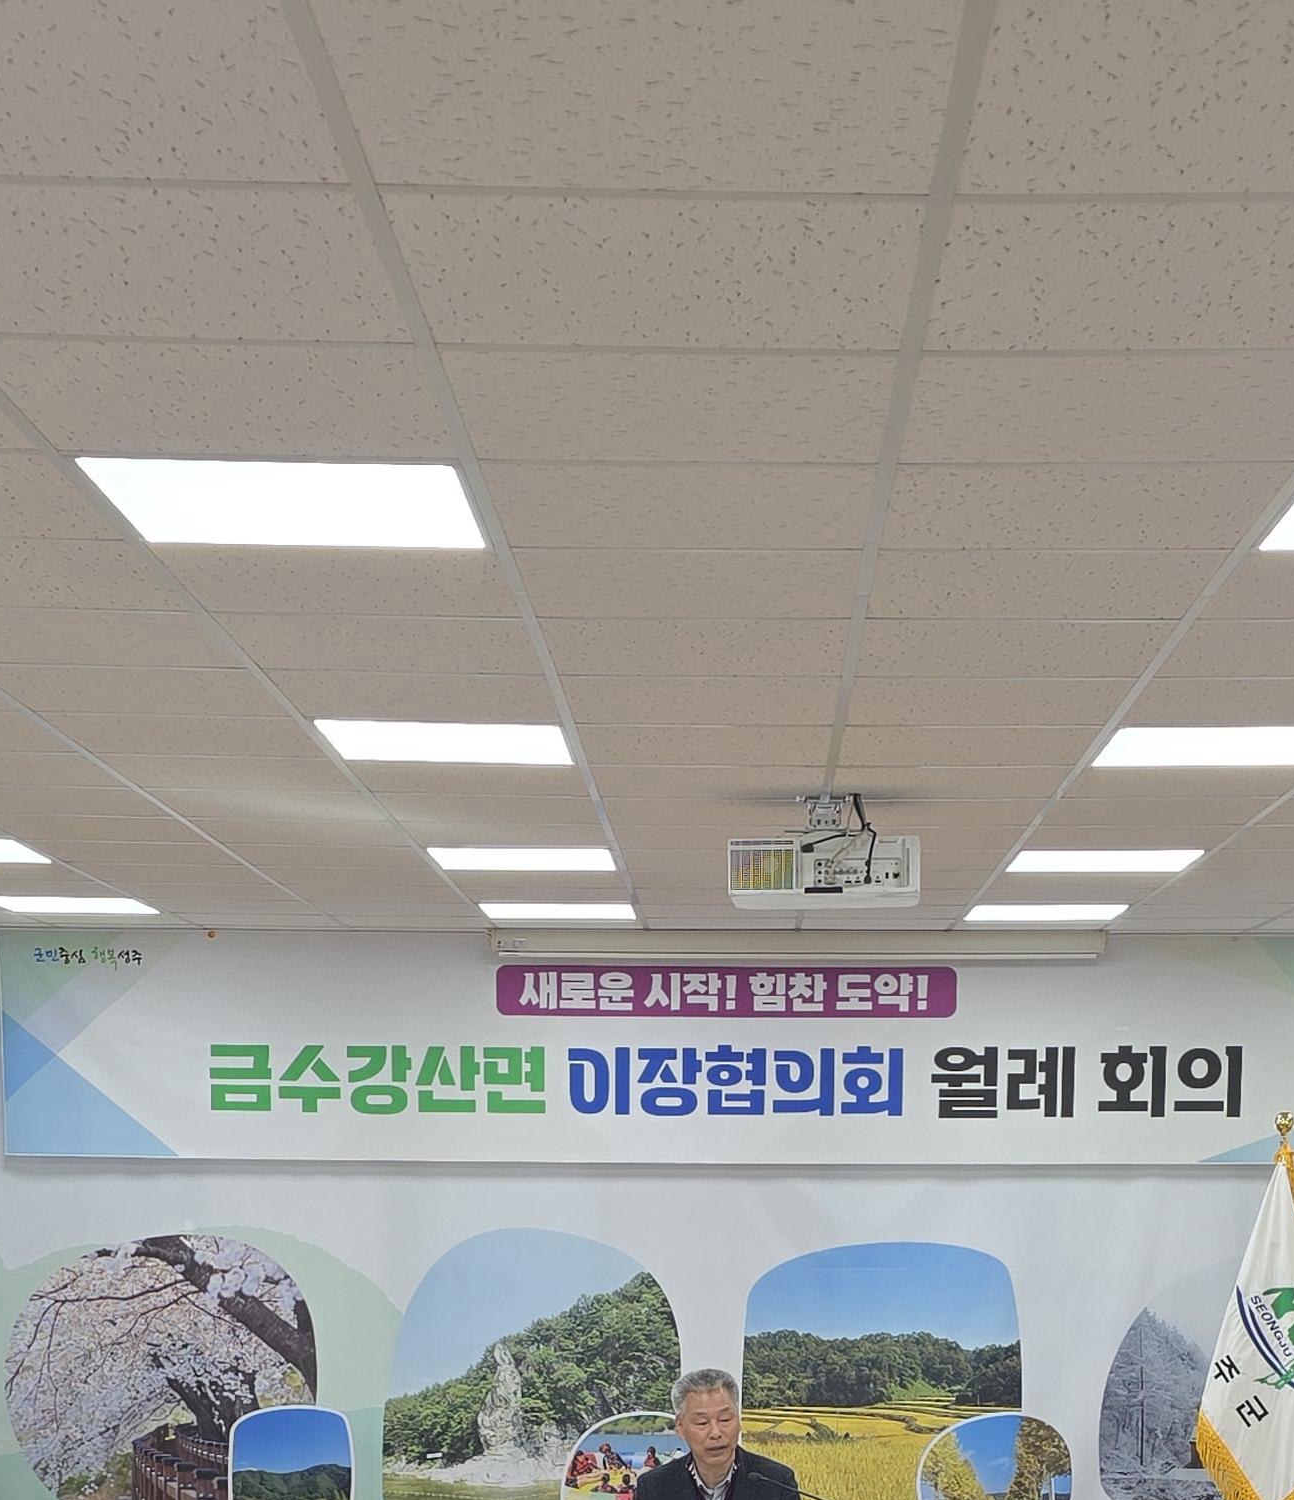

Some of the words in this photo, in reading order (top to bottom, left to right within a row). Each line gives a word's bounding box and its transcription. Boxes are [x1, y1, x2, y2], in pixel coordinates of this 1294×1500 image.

[33, 947, 86, 964] 군민중심
[91, 946, 143, 971] 행복성주
[518, 971, 635, 1011] 새로운
[644, 971, 737, 1011] 시작!
[749, 972, 827, 1012] 힘찬
[835, 973, 929, 1012] 도약!
[209, 1043, 547, 1115] 금수강산면
[568, 1044, 905, 1117] 이장협의회
[931, 1045, 1077, 1119] 월례
[1098, 1044, 1244, 1118] 회의
[1250, 1294, 1293, 1358] SEONGJU
